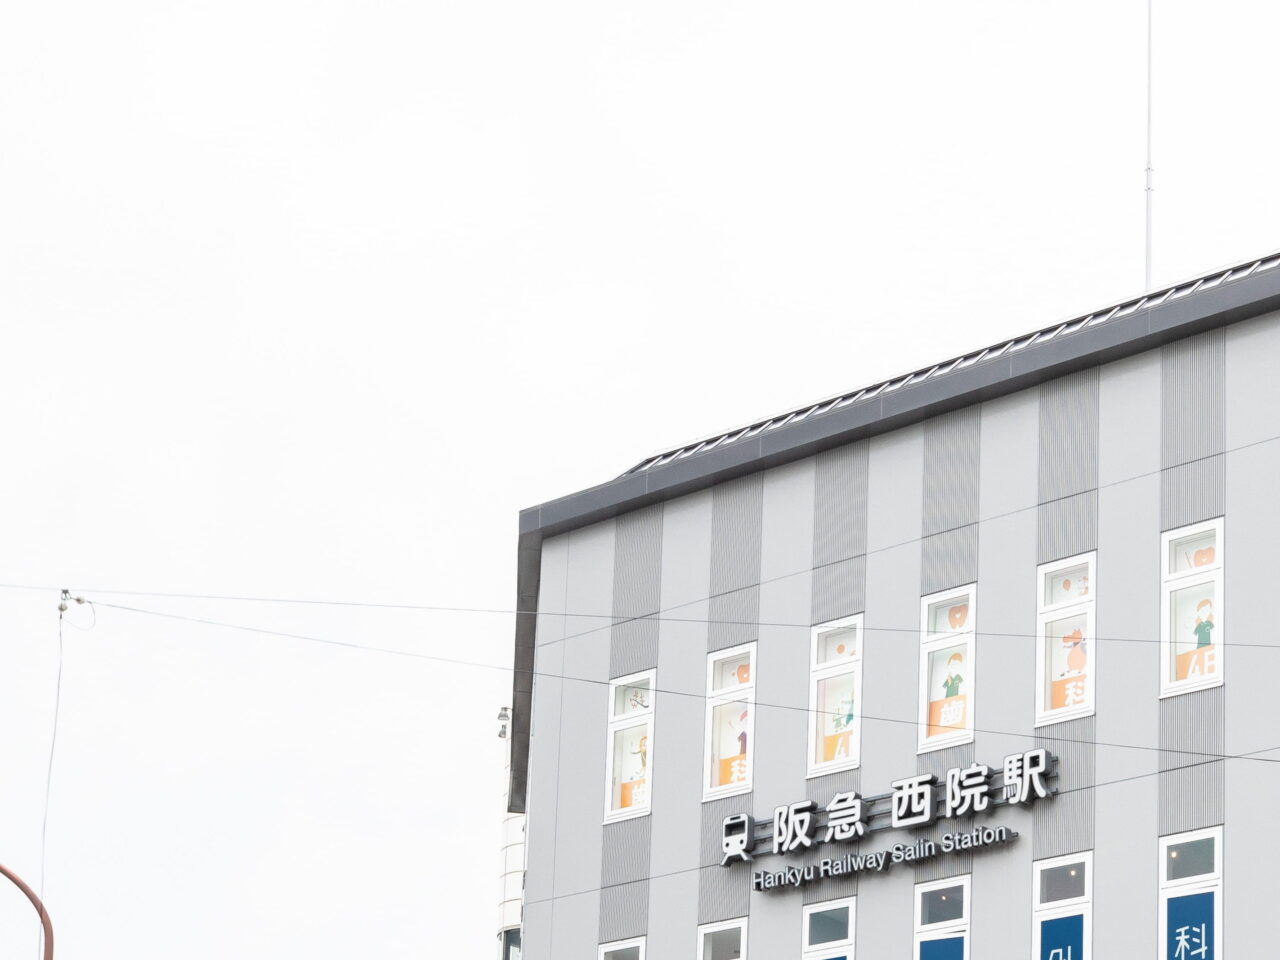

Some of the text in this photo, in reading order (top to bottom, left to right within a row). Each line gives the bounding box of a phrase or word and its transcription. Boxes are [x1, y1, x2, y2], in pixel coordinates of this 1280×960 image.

[772, 748, 1047, 854] 阪急 西院駅
[752, 824, 1007, 891] Hankyu Railway Saiin Station
